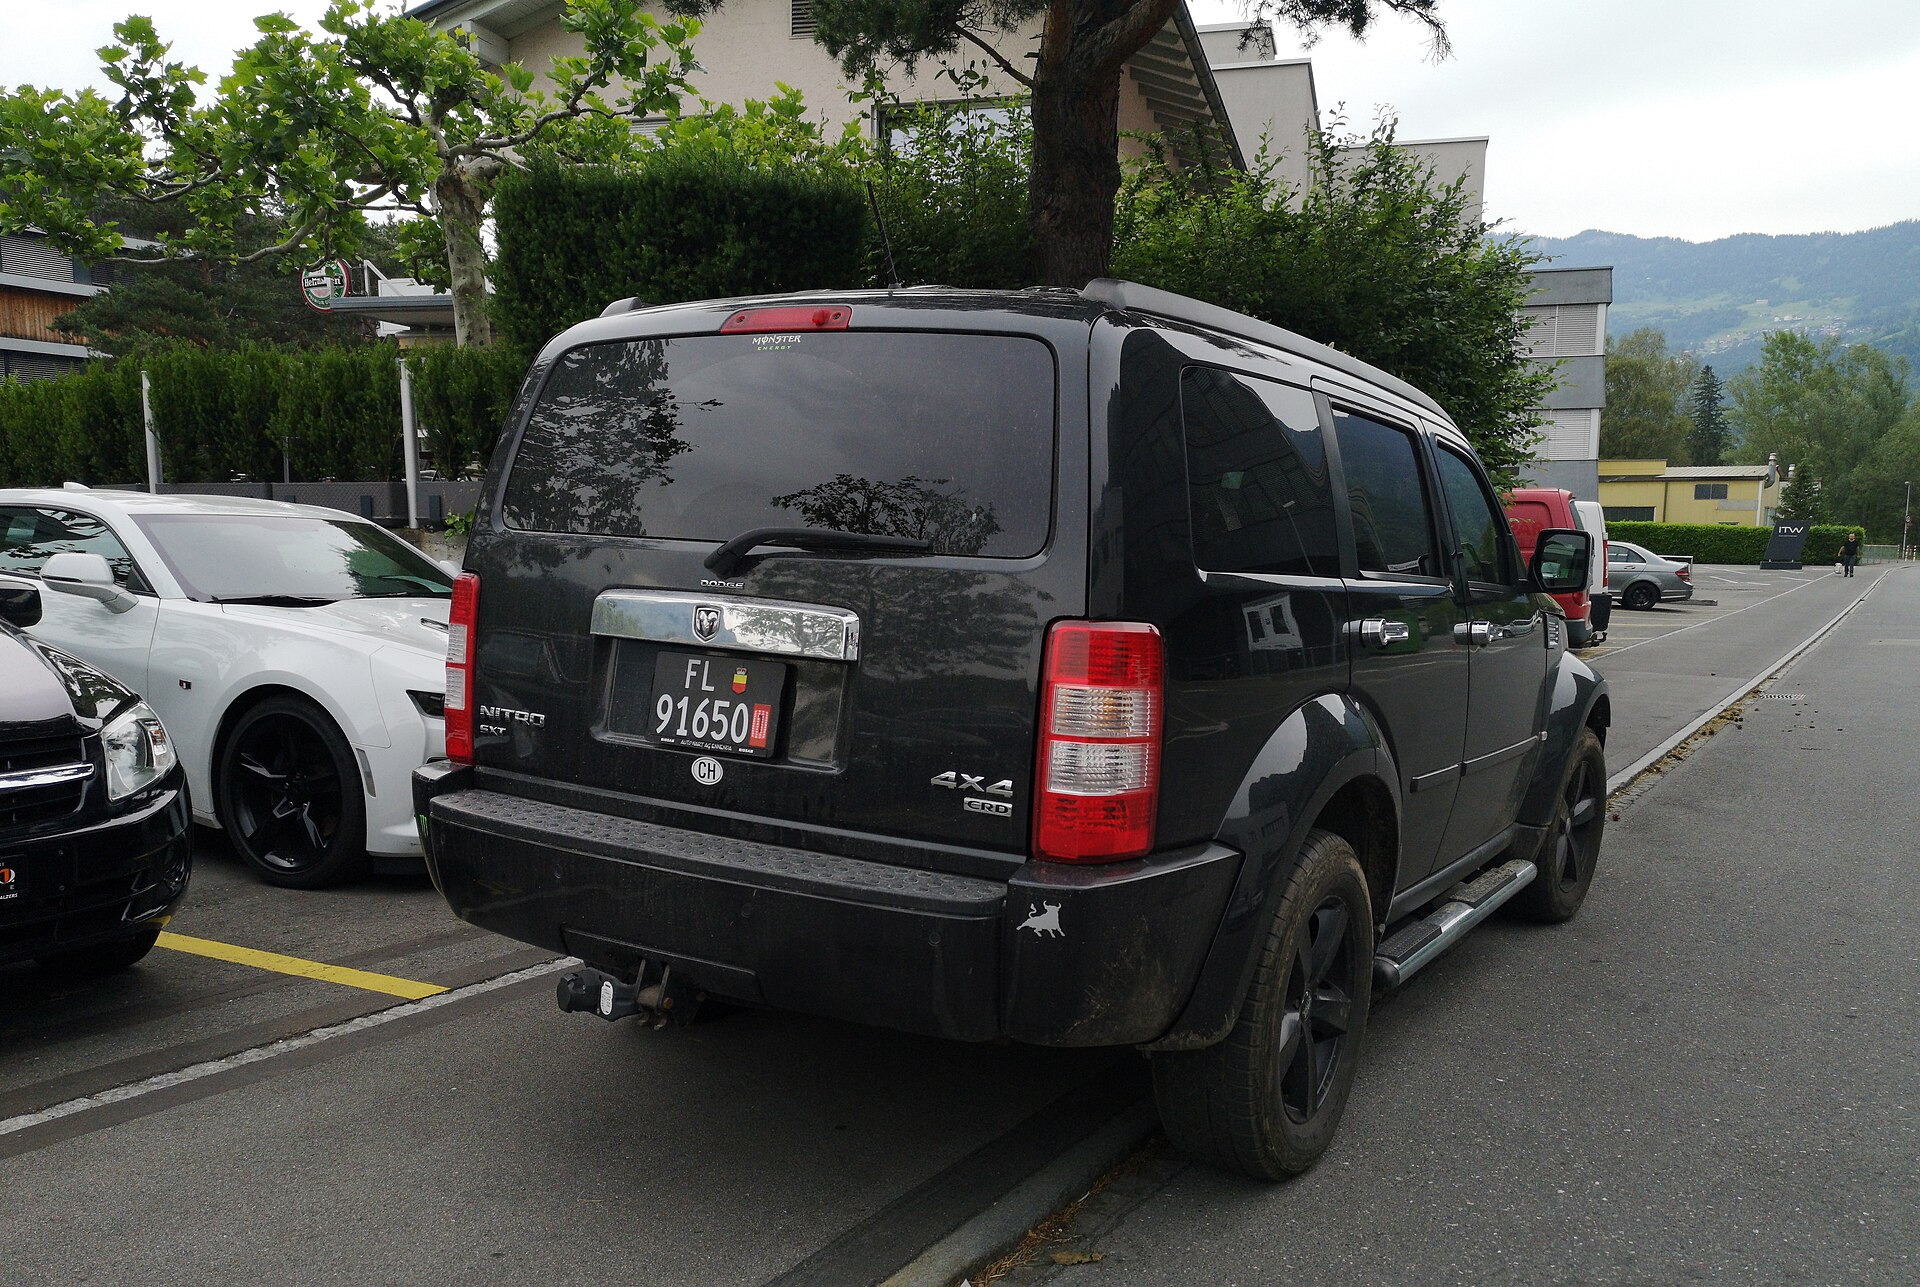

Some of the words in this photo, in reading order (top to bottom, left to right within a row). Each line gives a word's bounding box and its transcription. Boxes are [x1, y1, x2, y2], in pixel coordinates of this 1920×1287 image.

[700, 580, 744, 588] DODGE
[684, 659, 715, 692] FL
[480, 705, 545, 728] NITRO
[656, 694, 749, 743] 91650
[480, 724, 507, 736] SXT
[698, 761, 716, 780] CH
[967, 801, 1008, 814] CRD
